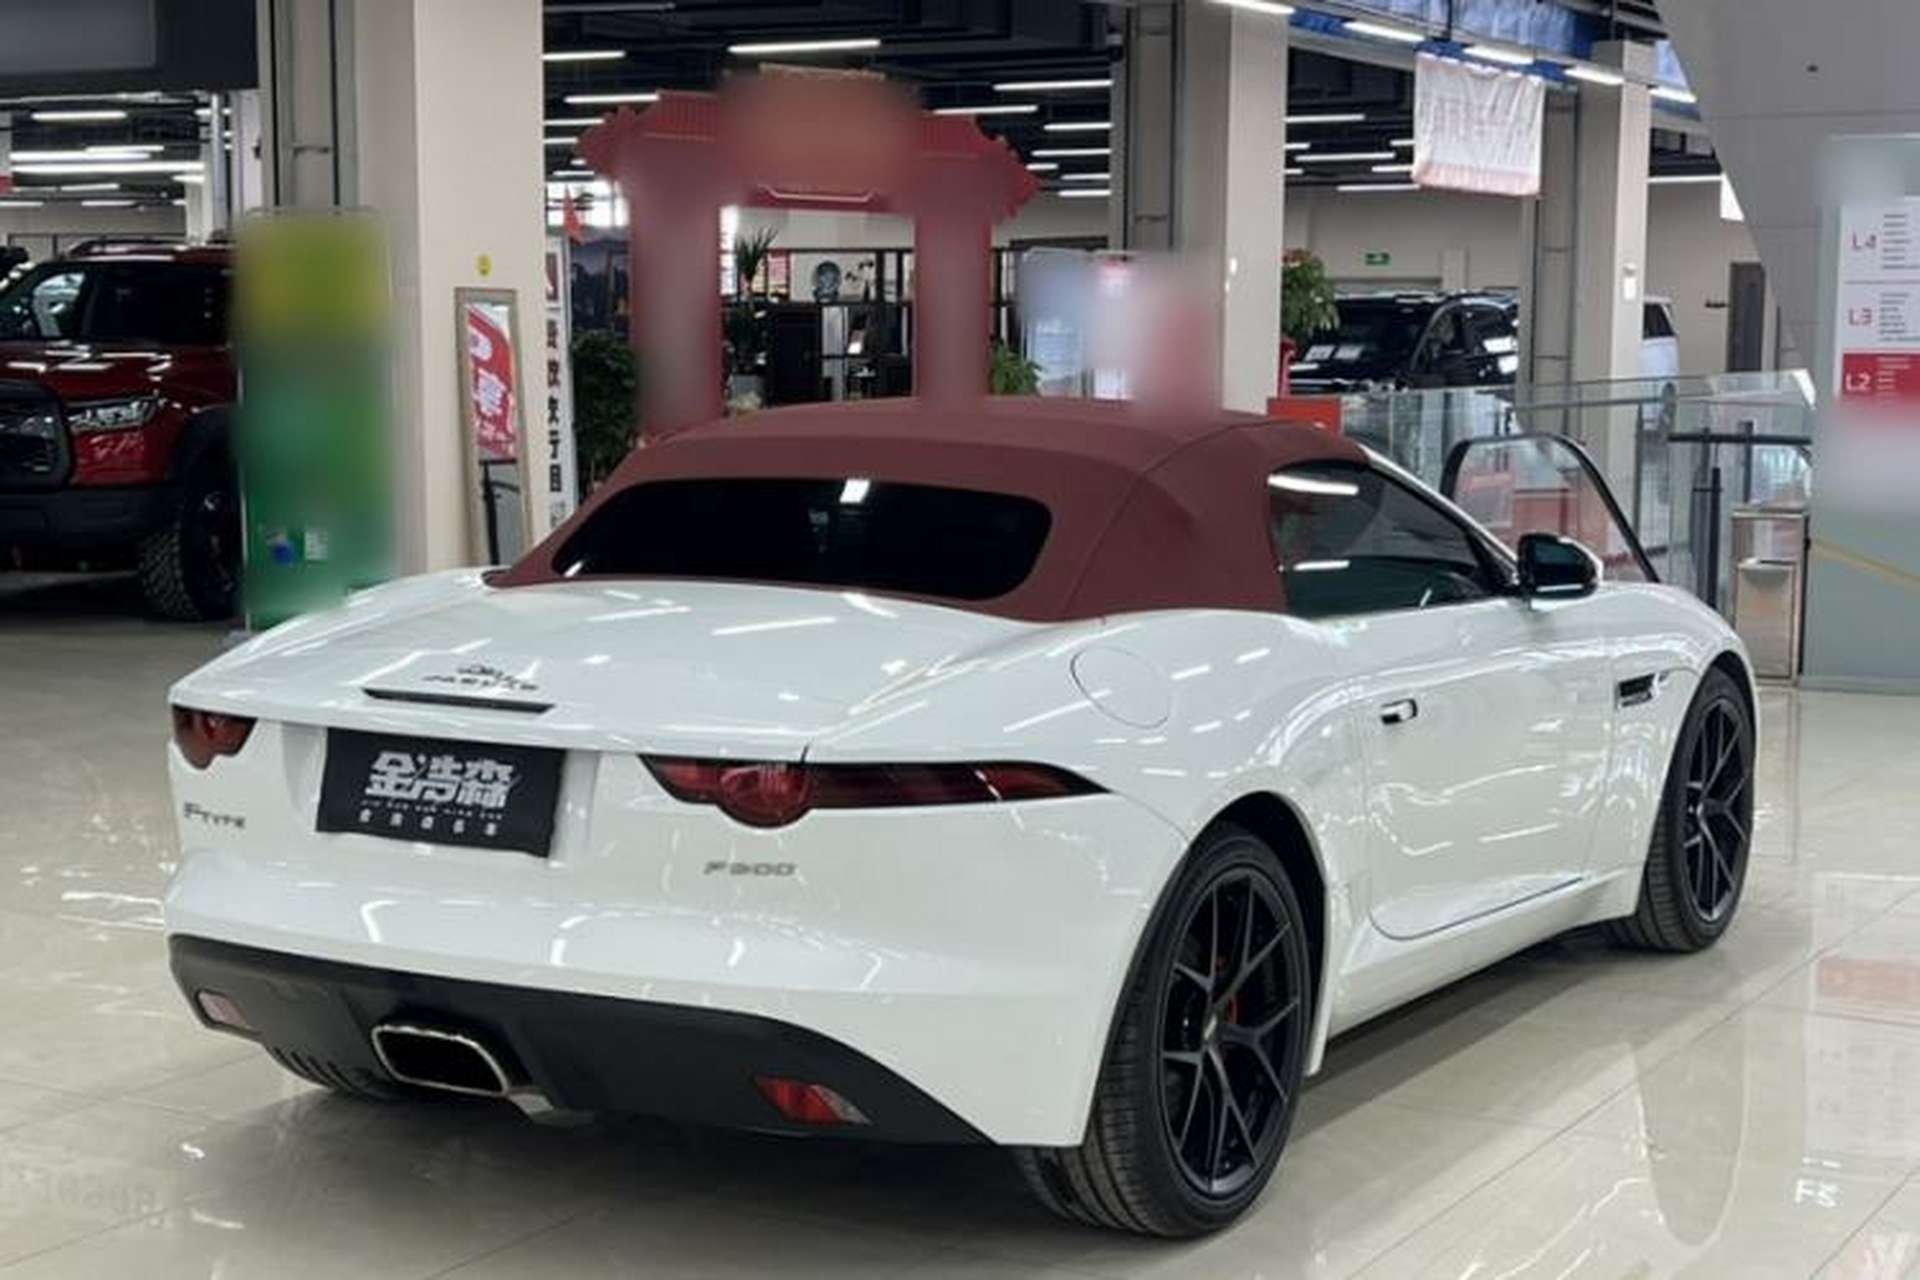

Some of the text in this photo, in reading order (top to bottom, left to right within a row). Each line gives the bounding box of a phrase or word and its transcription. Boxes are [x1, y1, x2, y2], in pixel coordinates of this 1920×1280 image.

[1852, 232, 1877, 250] L4
[1849, 307, 1873, 326] L3
[1845, 372, 1871, 391] L2
[364, 751, 516, 809] 金浩森
